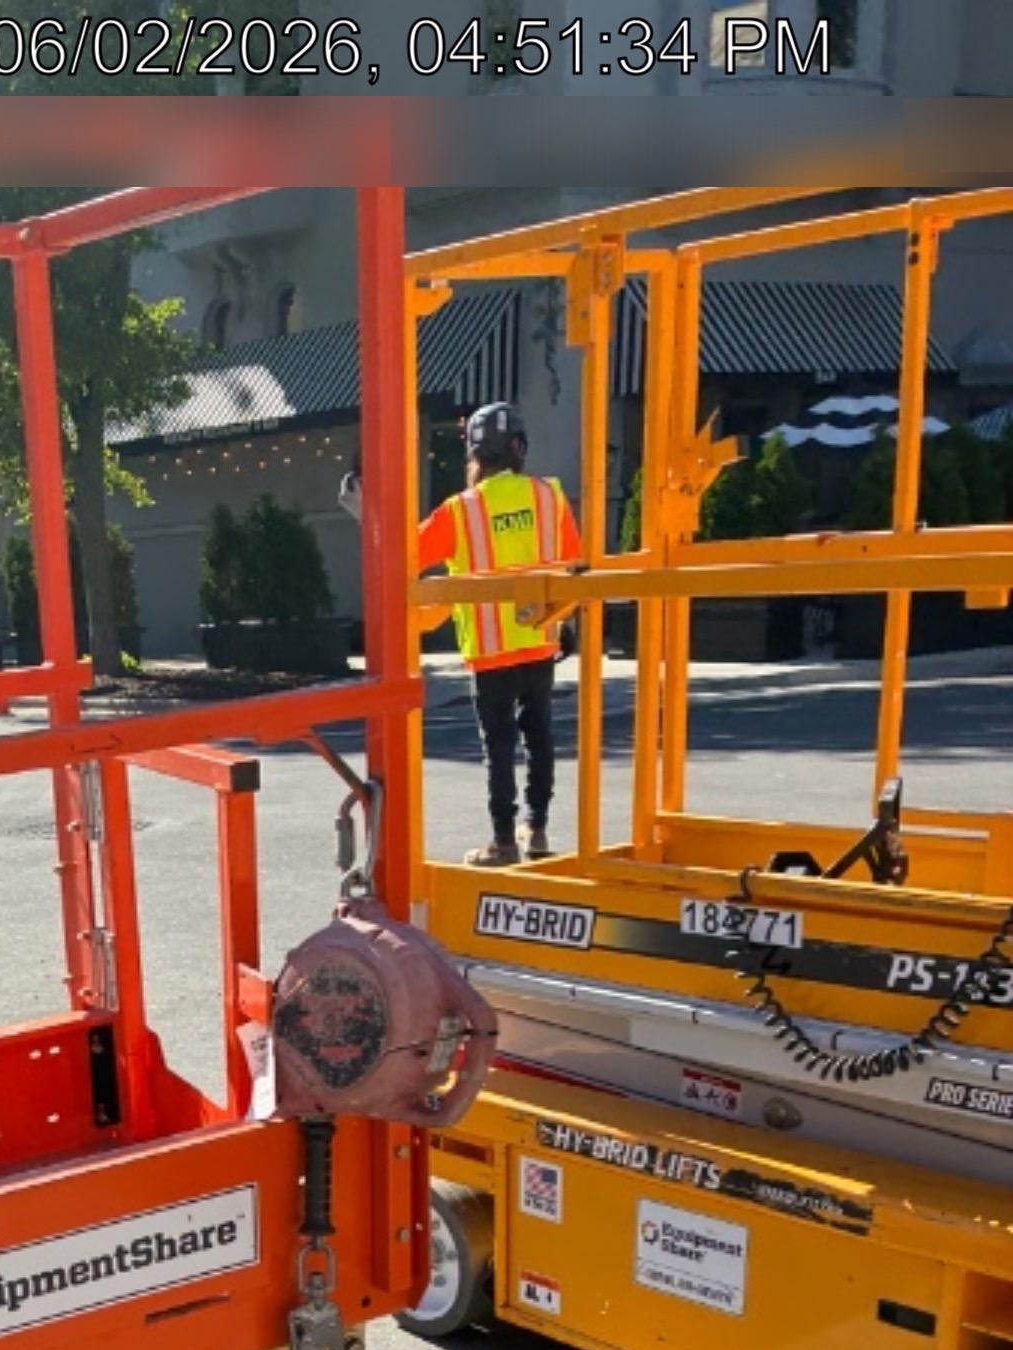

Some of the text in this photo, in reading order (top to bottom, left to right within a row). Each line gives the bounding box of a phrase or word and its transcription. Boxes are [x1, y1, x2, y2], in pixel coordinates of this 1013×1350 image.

[482, 901, 586, 942] HY-BRID
[929, 1081, 967, 1105] PRO
[553, 1123, 721, 1189] HY-BRID LIFTS
[660, 1238, 704, 1263] Share
[661, 1220, 742, 1258] Equipment
